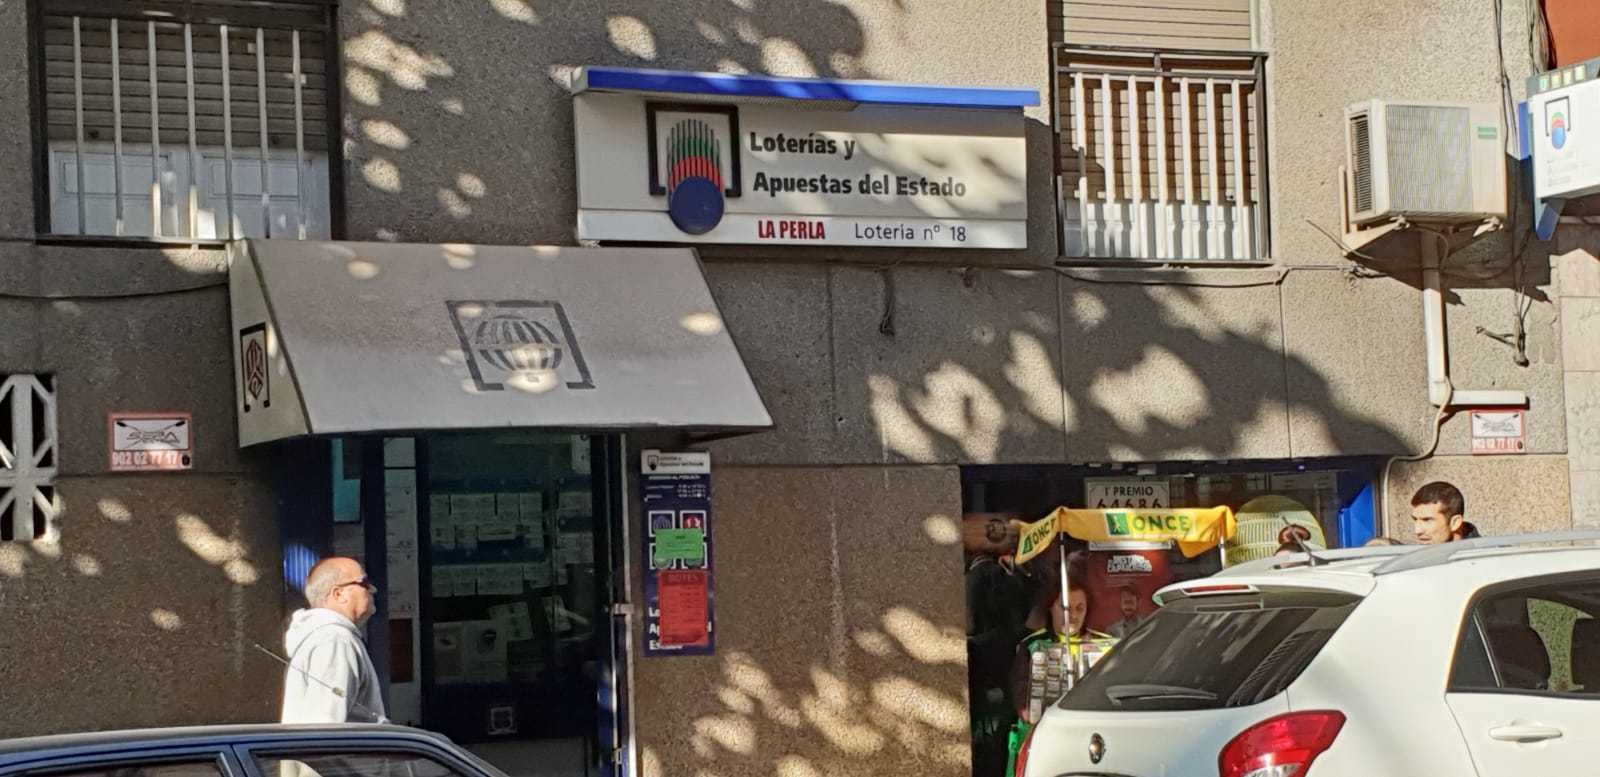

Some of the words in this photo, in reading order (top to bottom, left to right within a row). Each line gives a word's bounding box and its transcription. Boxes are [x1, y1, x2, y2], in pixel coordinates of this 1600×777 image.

[750, 131, 837, 154] Loterías
[844, 139, 856, 160] y
[753, 171, 852, 197] Apuestas
[858, 174, 889, 195] del
[896, 176, 967, 197] Estado
[758, 220, 776, 239] LA
[779, 221, 826, 240] PERLA
[950, 226, 967, 242] 18
[112, 451, 132, 466] 902
[1113, 485, 1154, 497] PREMIO
[1132, 515, 1190, 532] ONCE
